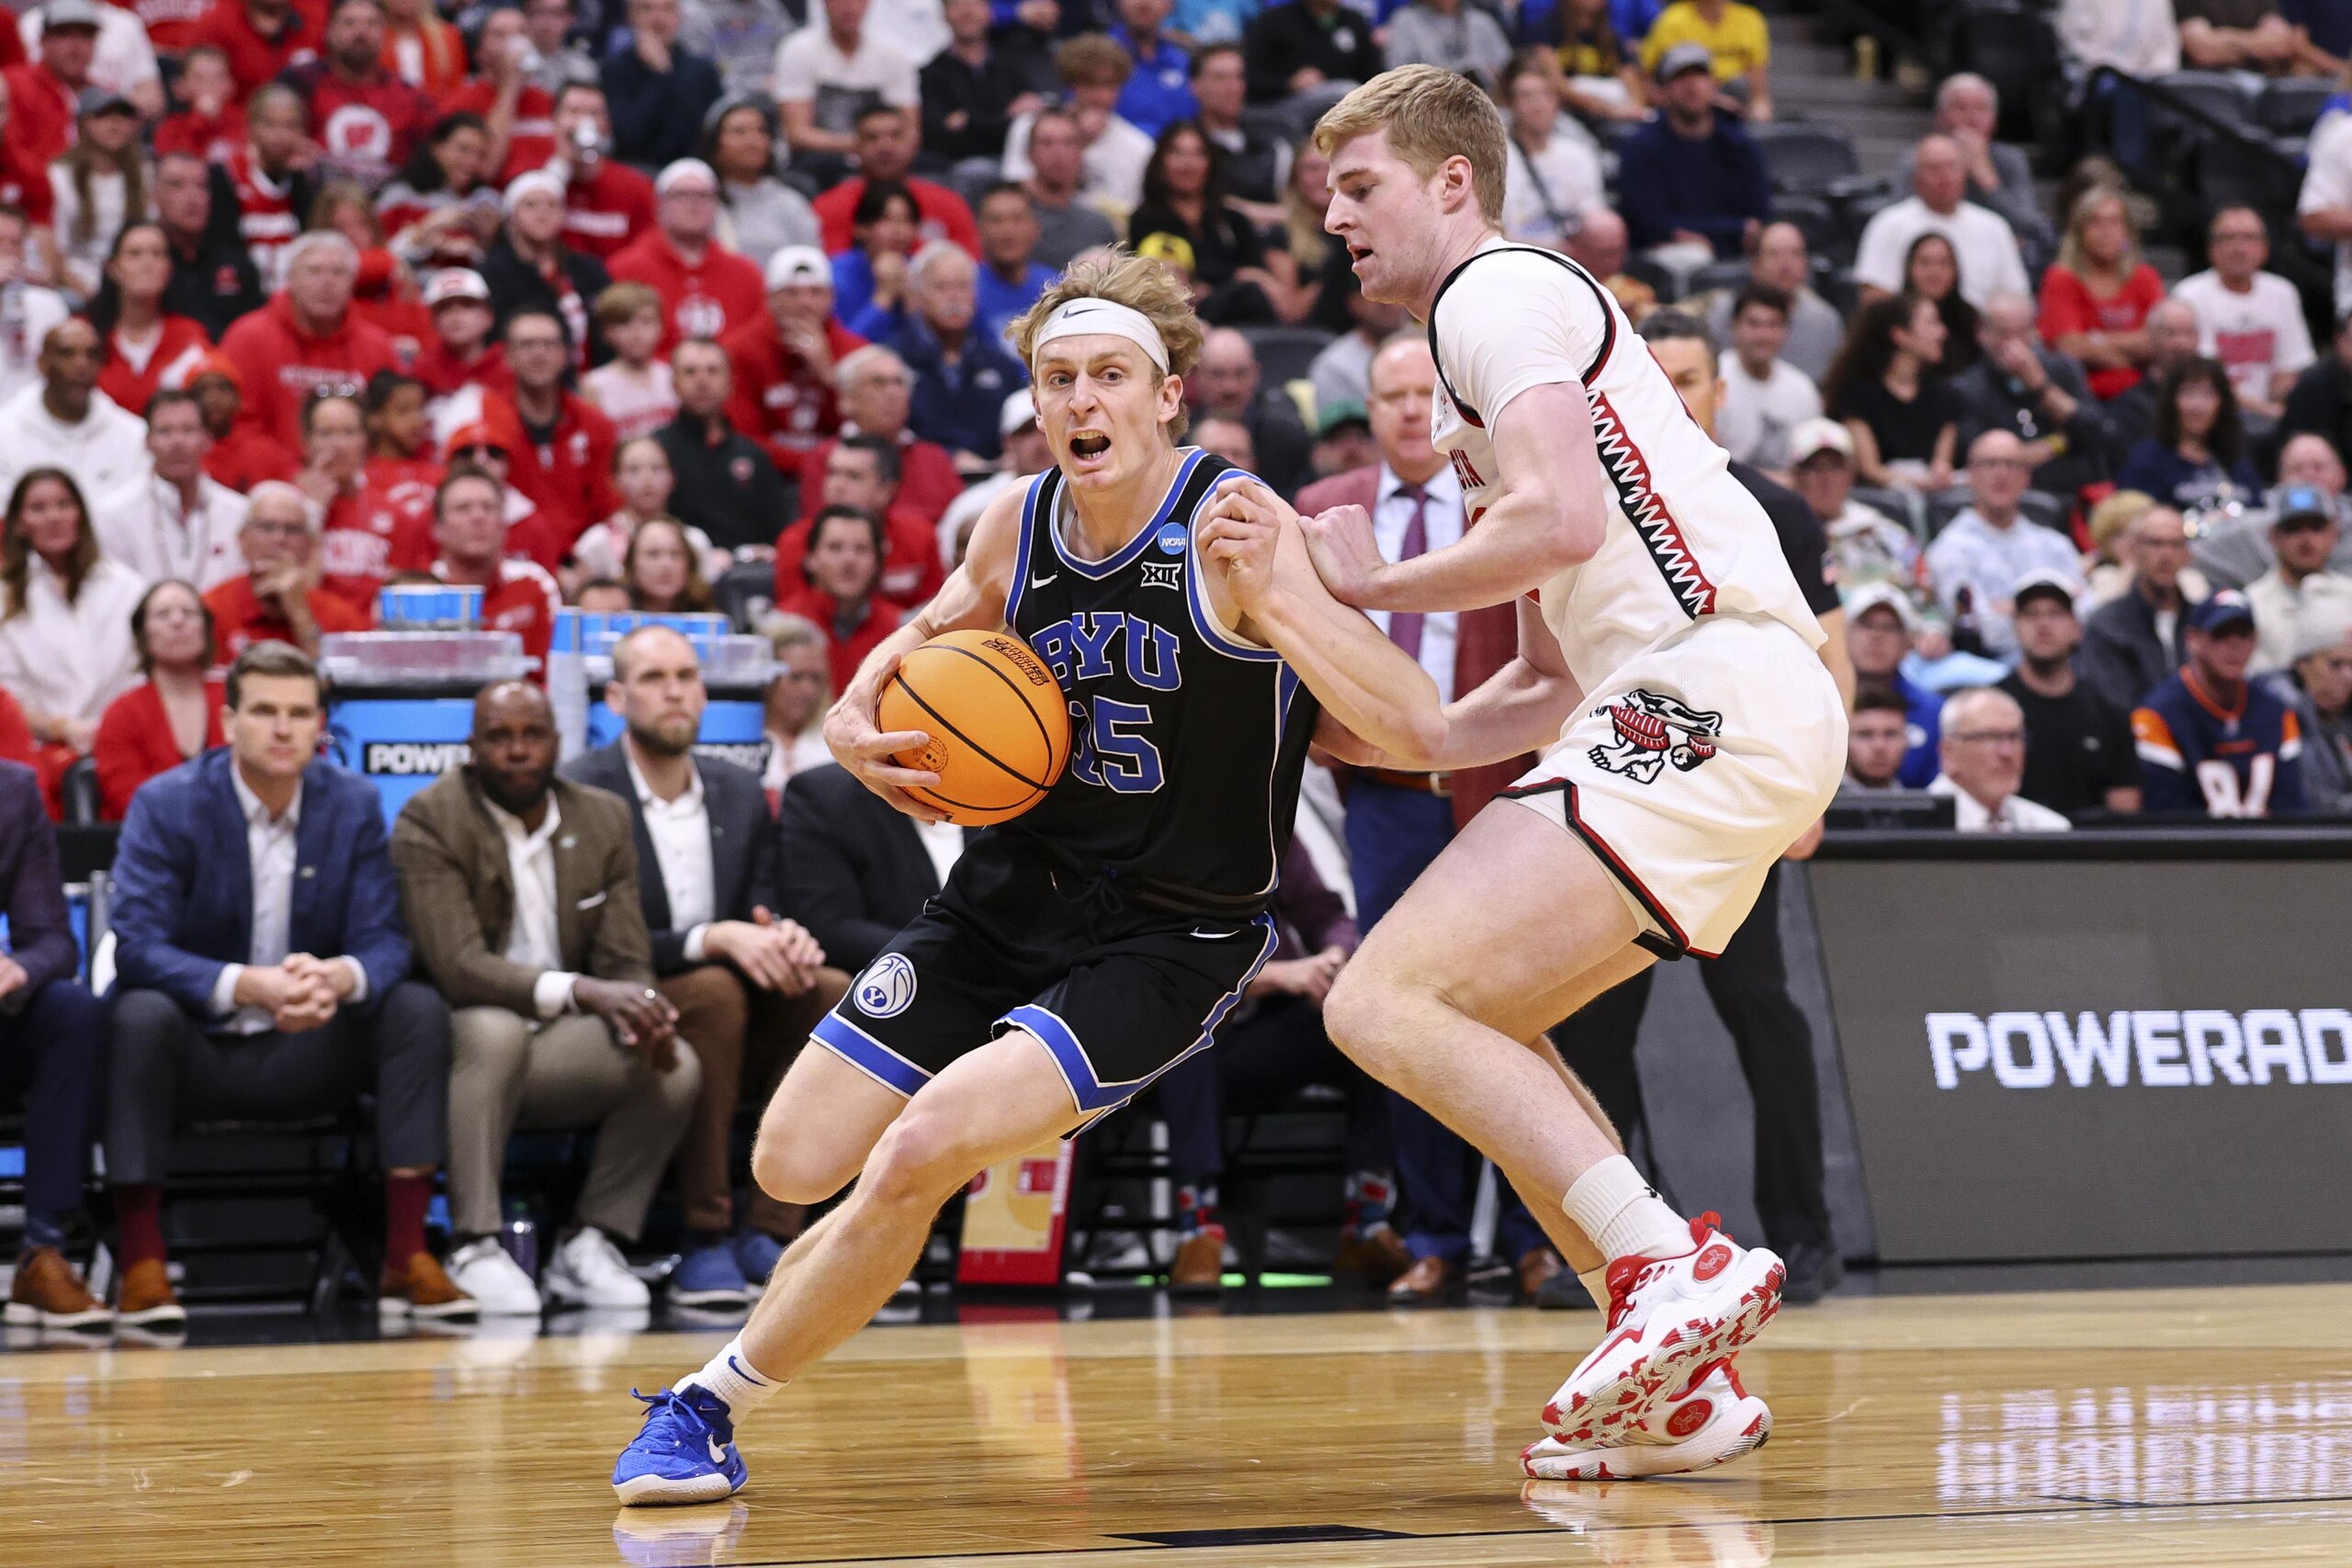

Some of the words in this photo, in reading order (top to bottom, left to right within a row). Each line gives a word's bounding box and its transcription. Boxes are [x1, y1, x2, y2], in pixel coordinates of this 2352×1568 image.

[1161, 536, 1187, 547] NCAA
[1140, 560, 1182, 591] XII
[1001, 647, 1045, 686] MADNESS
[1007, 641, 1036, 669] MARCH
[1029, 611, 1182, 692] BYU
[1069, 694, 1166, 794] 15
[1925, 1009, 2352, 1089] POWERAD
